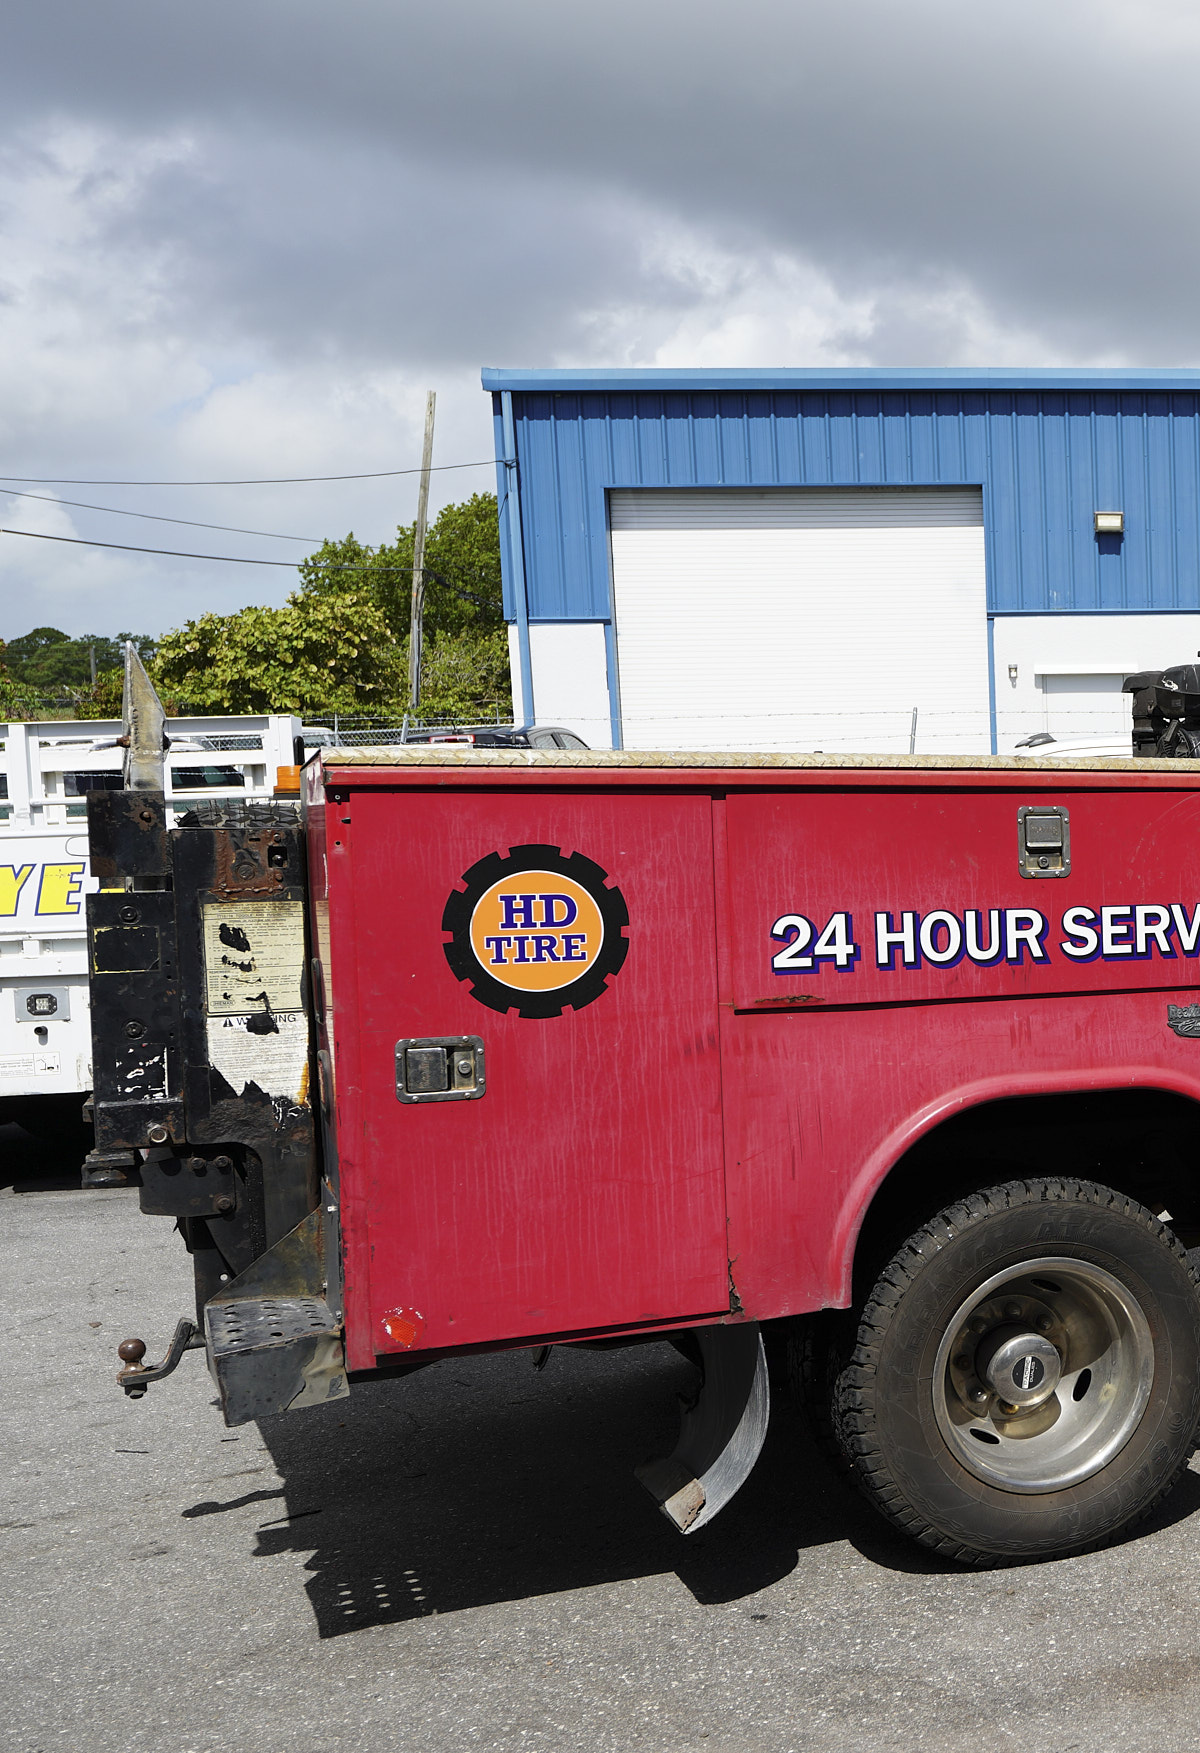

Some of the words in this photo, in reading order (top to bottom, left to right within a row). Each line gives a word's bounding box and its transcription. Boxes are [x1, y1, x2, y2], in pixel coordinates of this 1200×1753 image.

[498, 893, 578, 930] HD
[484, 933, 588, 965] TIRE
[770, 912, 861, 975] 24
[875, 908, 1051, 970] HOUR
[236, 1013, 296, 1027] WING
